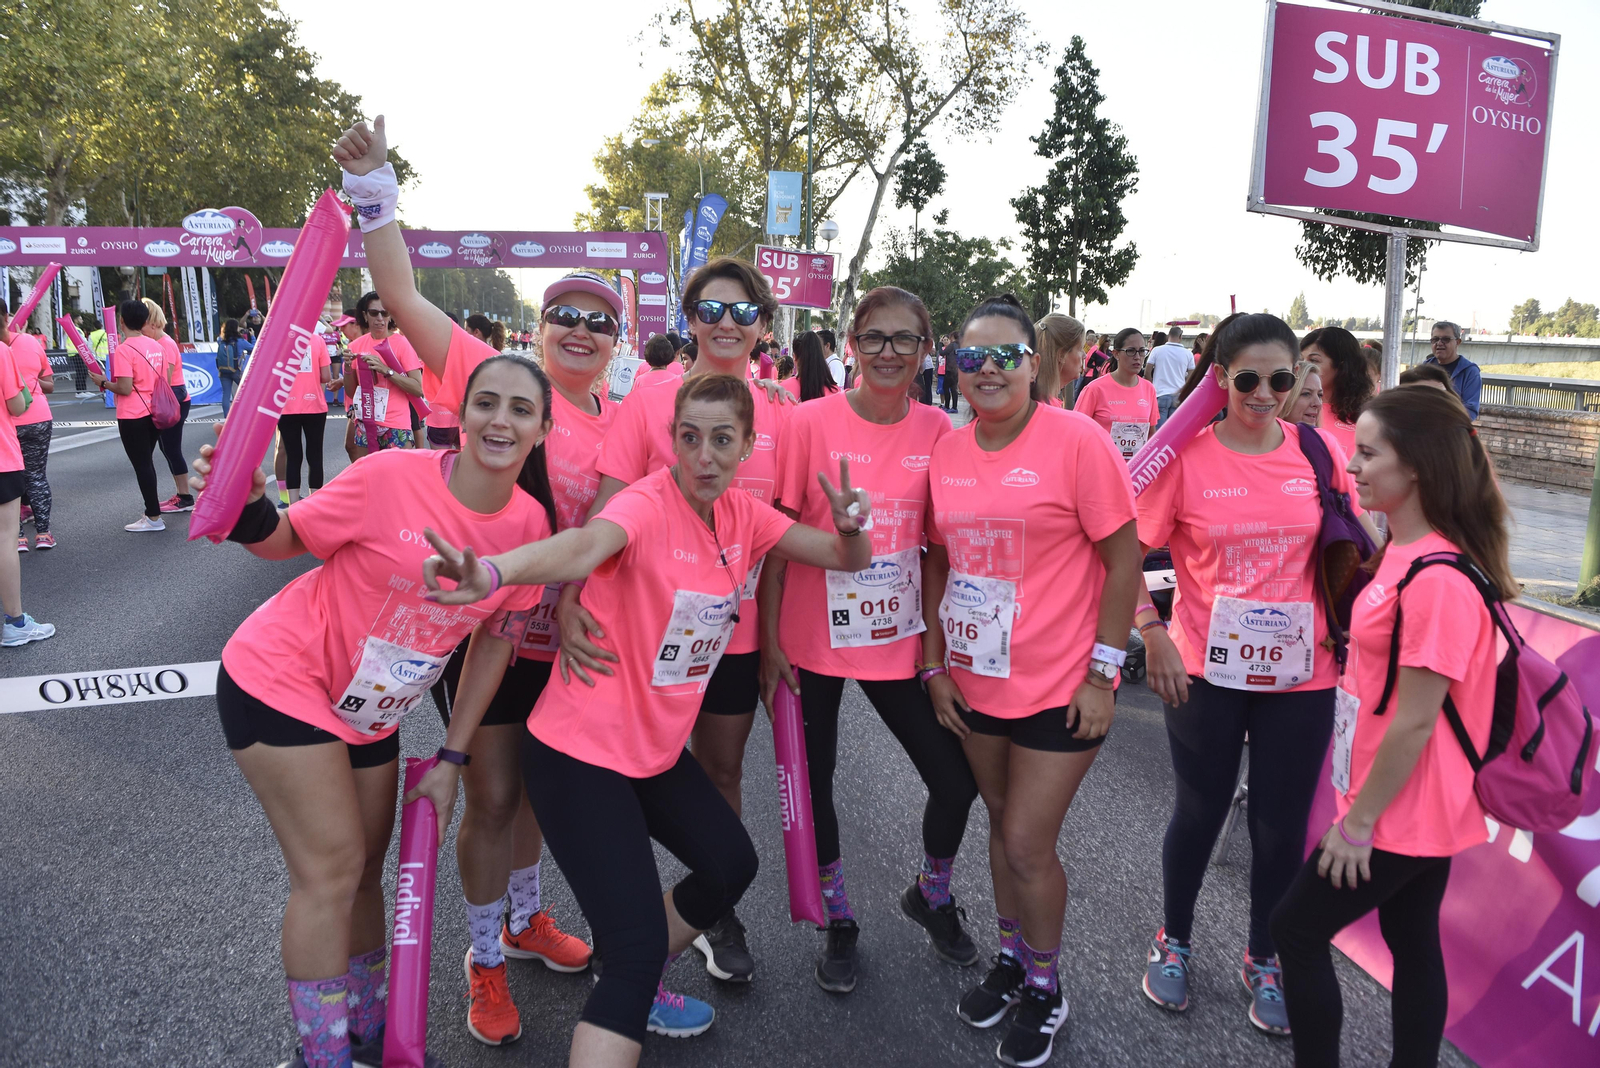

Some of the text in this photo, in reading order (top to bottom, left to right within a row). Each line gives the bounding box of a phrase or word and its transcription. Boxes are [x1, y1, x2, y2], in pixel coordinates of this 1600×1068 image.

[1312, 30, 1441, 96] SUB
[1486, 61, 1518, 76] ASTURIANA
[1478, 71, 1510, 89] Carrera
[1495, 88, 1520, 105] Mujer
[1472, 105, 1542, 135] OYSHO
[1303, 111, 1449, 195] 35'
[187, 219, 232, 230] ASTURIANA
[101, 241, 139, 250] OYSHO
[179, 232, 223, 247] Carrera
[461, 237, 491, 245] ASTURIANA
[146, 246, 178, 254] ASTURIANA
[190, 245, 240, 266] de la Mujer
[457, 246, 484, 256] Carrera
[512, 246, 544, 254] ASTURIANA
[549, 245, 583, 254] OYSHO
[473, 255, 494, 267] Mujer
[761, 251, 799, 270] SUB
[808, 272, 833, 281] OYSHO
[639, 315, 666, 323] OYSHO
[363, 392, 372, 419] Ladival
[1120, 439, 1137, 447] 016
[1132, 444, 1177, 498] Ladiva
[941, 475, 977, 487] OYSHO
[1203, 486, 1248, 499] OYSHO
[893, 510, 918, 519] GASTEIZ
[875, 517, 902, 526] MADRID
[957, 529, 1013, 539] VITORIA GASTEIZ
[1208, 521, 1268, 537] HOY GANAN
[969, 537, 995, 547] MADRID
[1244, 535, 1307, 547] VITORIA GASTEIZ
[1259, 544, 1288, 553] MADRID
[857, 570, 899, 581] ASTURIANA
[388, 573, 415, 593] HOY
[420, 604, 448, 618] VITORIA
[860, 596, 900, 616] 016
[428, 615, 457, 627] MADRID
[530, 621, 550, 632] 5538
[871, 617, 893, 627] 4738
[1243, 616, 1288, 628] ASTURIANA
[947, 617, 978, 640] 016
[836, 632, 862, 640] OYSHO
[690, 635, 722, 656] 016
[951, 639, 968, 651] 5536
[1240, 644, 1284, 662] 016
[692, 655, 710, 664] 4845
[1248, 664, 1272, 673] 4739
[1209, 671, 1237, 681] OYSHO
[393, 862, 424, 946] Ladival
